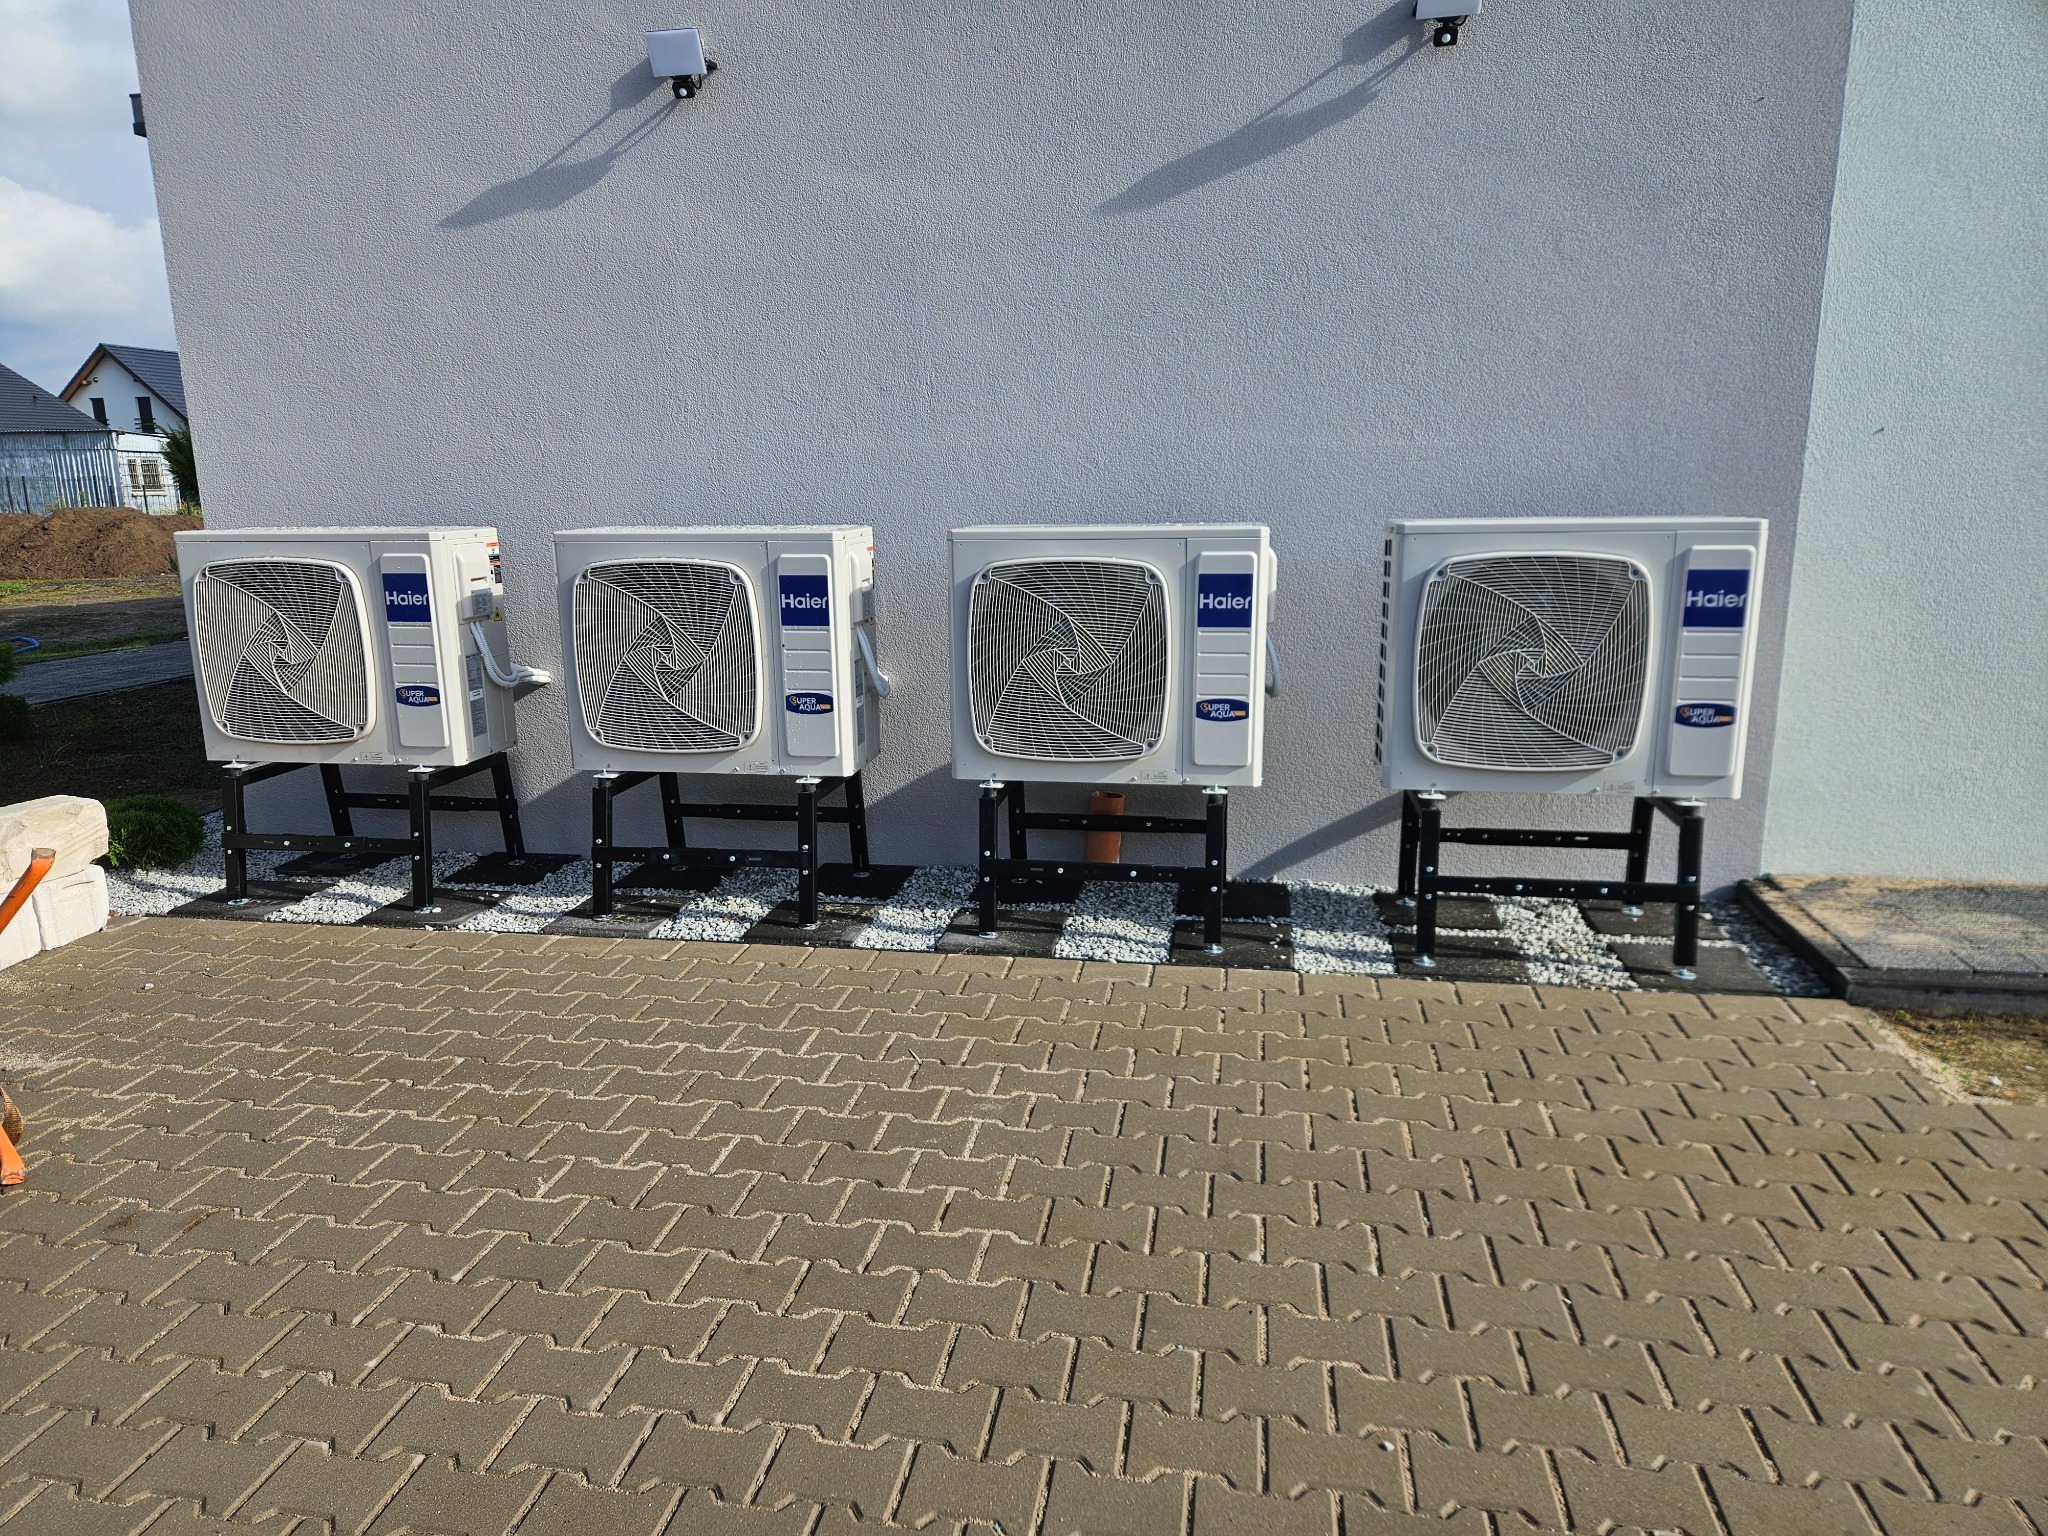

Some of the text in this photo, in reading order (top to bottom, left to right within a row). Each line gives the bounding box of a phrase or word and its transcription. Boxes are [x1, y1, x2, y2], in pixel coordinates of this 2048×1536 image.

[385, 590, 428, 605] Haier
[781, 593, 828, 608] Haier
[1199, 592, 1252, 609] Haier
[1686, 590, 1747, 608] Haier
[399, 689, 424, 698] SUPER
[408, 696, 429, 704] AQUA
[790, 696, 816, 706] SUPER
[799, 704, 821, 712] AQUA
[1200, 703, 1230, 713] SUPER
[1210, 710, 1234, 718] AQUA
